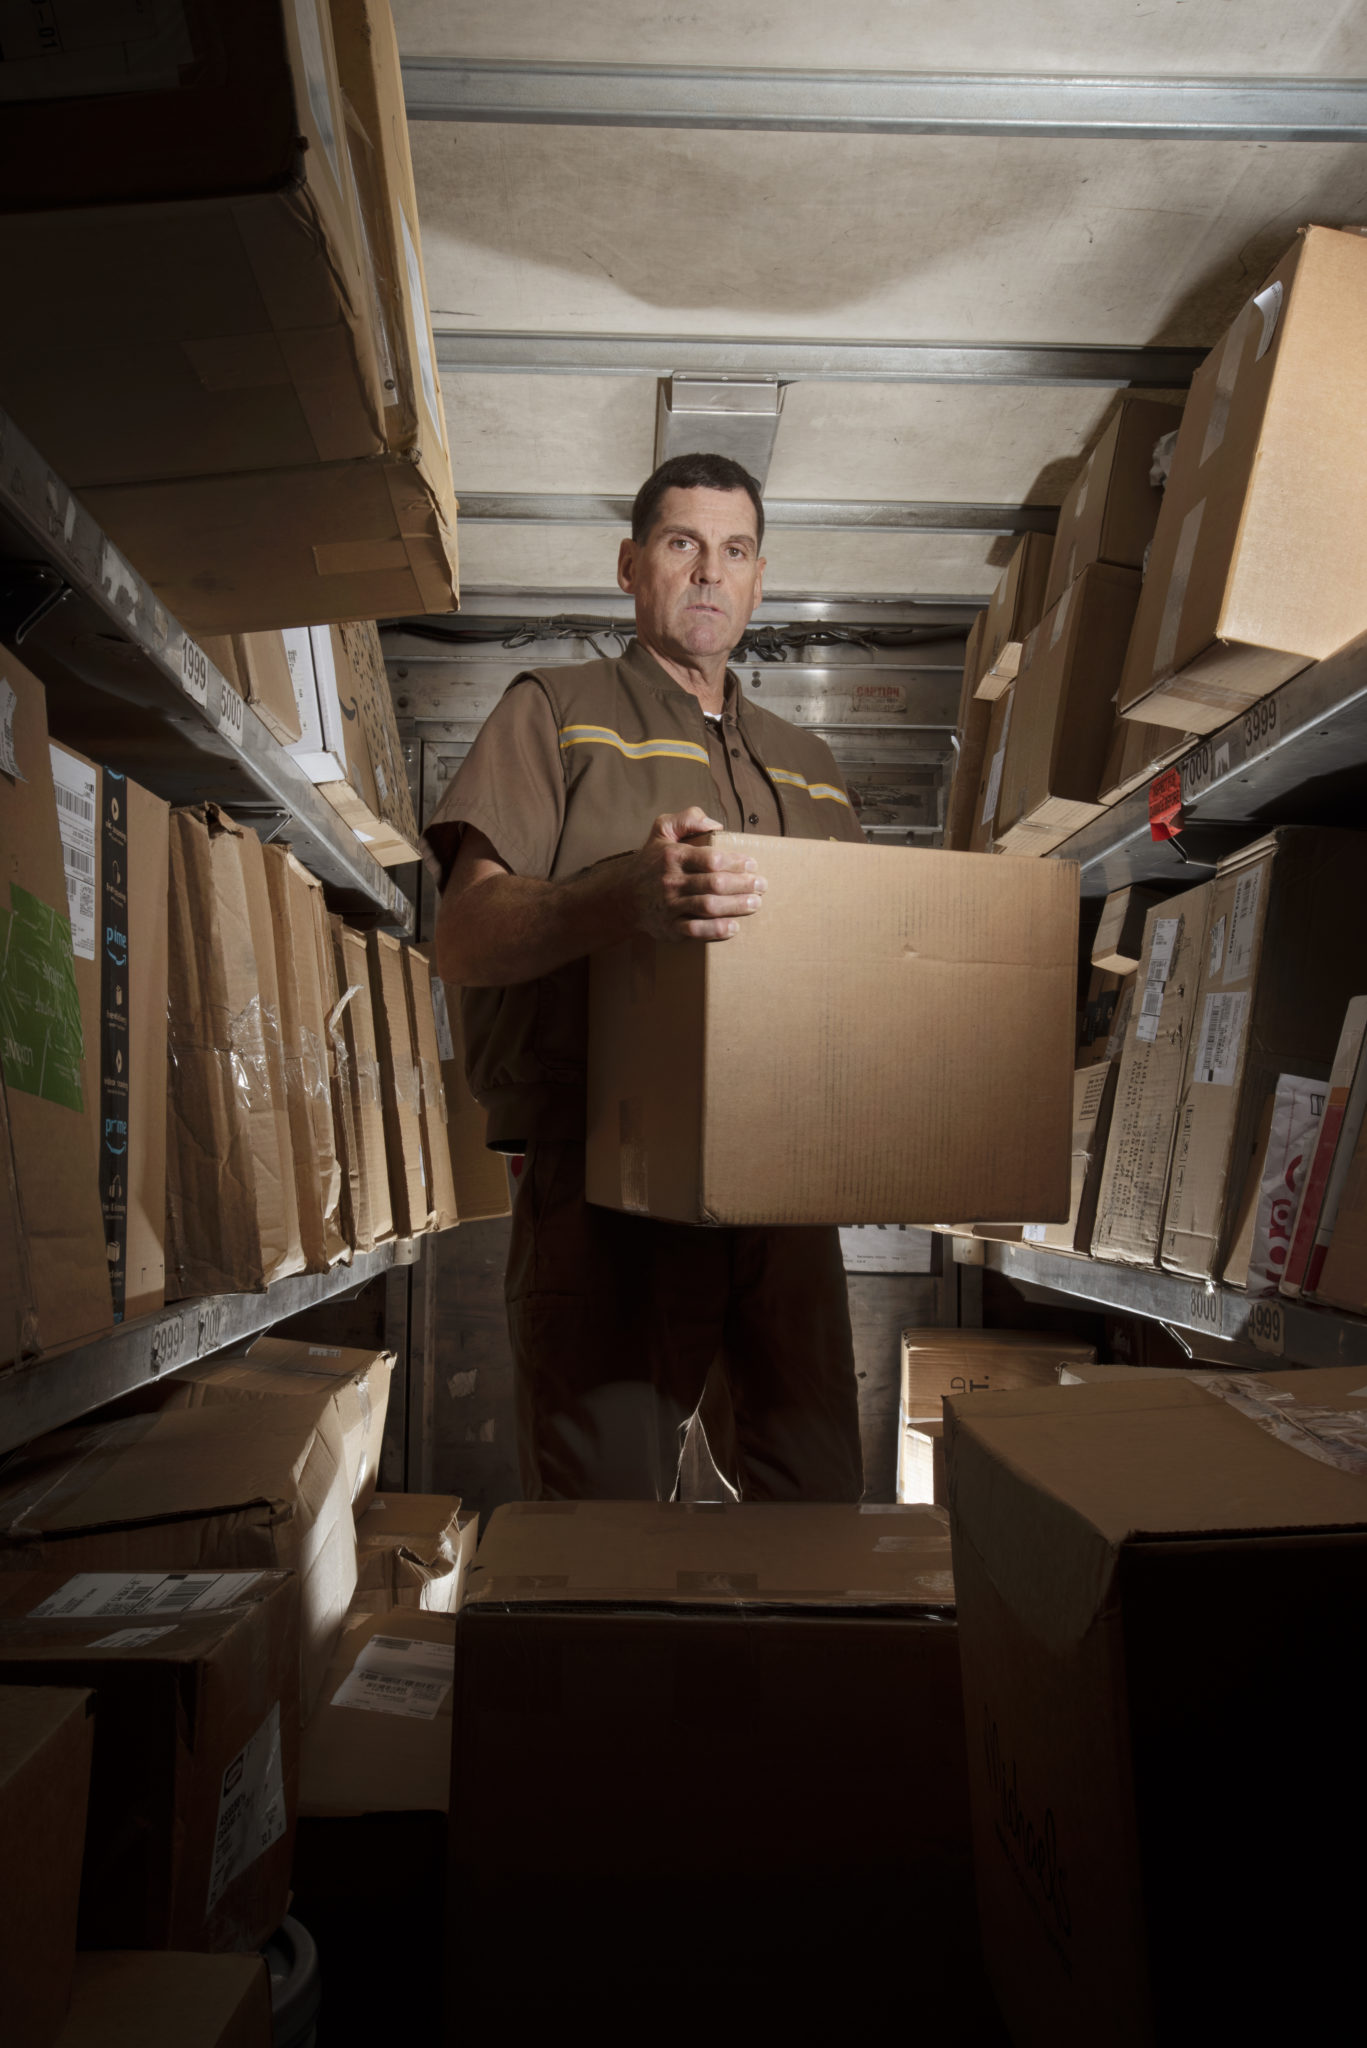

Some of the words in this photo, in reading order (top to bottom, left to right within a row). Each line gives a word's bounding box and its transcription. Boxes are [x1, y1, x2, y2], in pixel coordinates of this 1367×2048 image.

[182, 638, 206, 691] 1999
[221, 684, 242, 731] 5000
[856, 686, 900, 697] CAUTION
[1245, 699, 1277, 747] 3999
[1182, 746, 1209, 791] 7000
[106, 924, 127, 949] pime
[105, 1115, 128, 1137] prme
[1190, 1287, 1217, 1322] 8000
[1248, 1304, 1280, 1342] 4999
[984, 1702, 1073, 1938] Michaels
